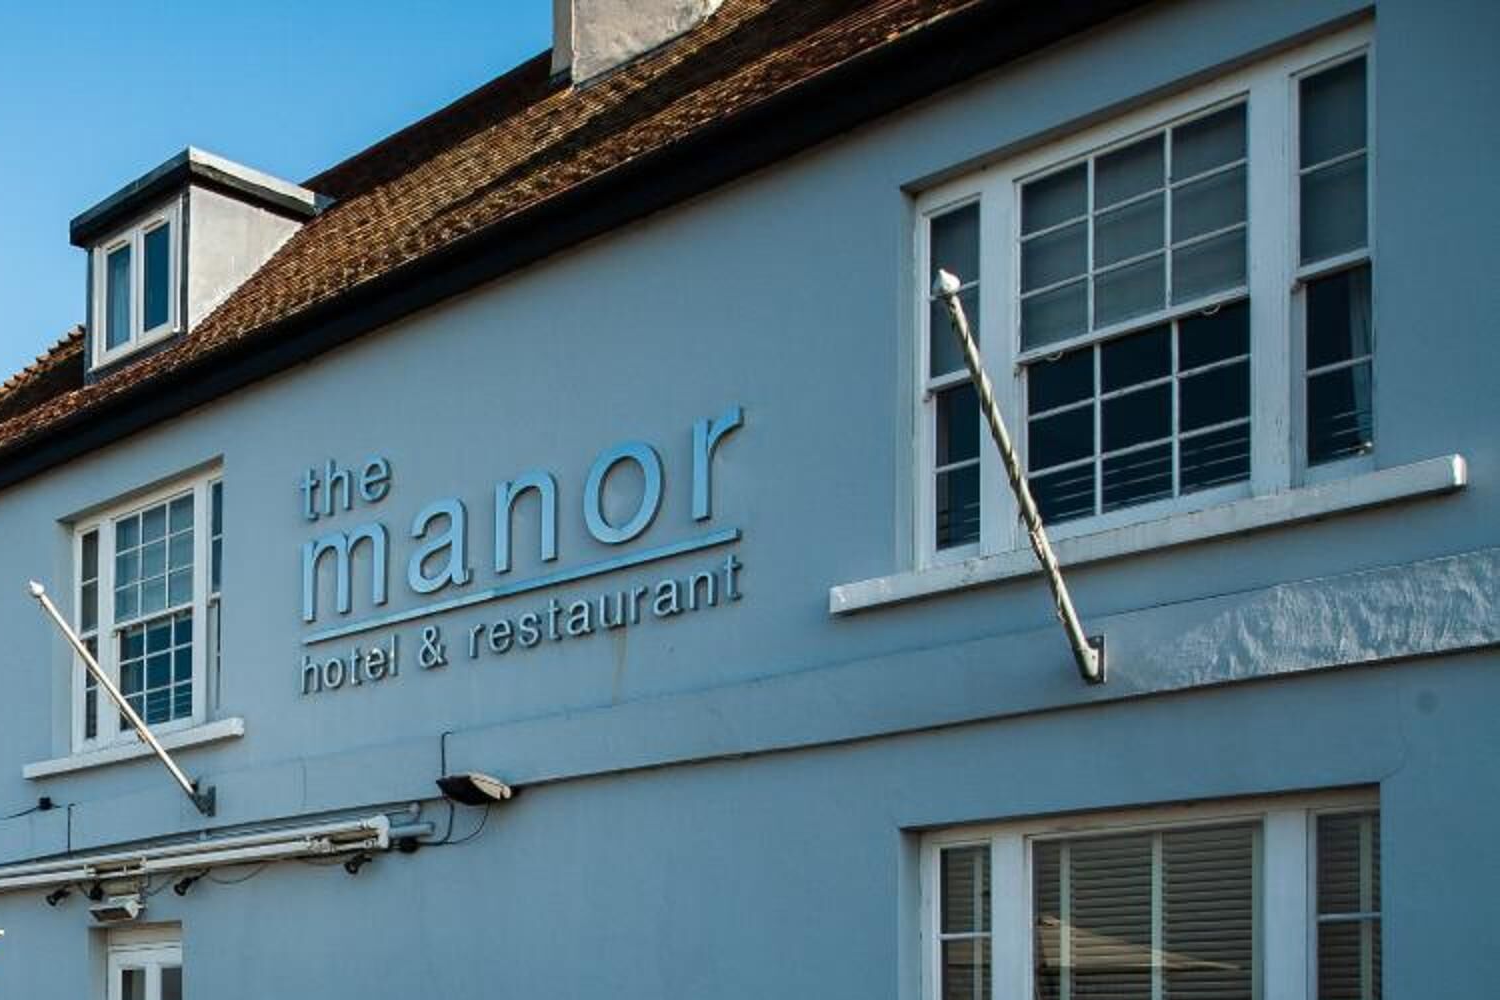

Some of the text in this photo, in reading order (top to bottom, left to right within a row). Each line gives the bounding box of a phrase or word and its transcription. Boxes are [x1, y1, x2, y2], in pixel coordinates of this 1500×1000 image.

[301, 454, 391, 520] the
[303, 404, 743, 622] manor
[301, 554, 742, 694] hotel & restaurant
